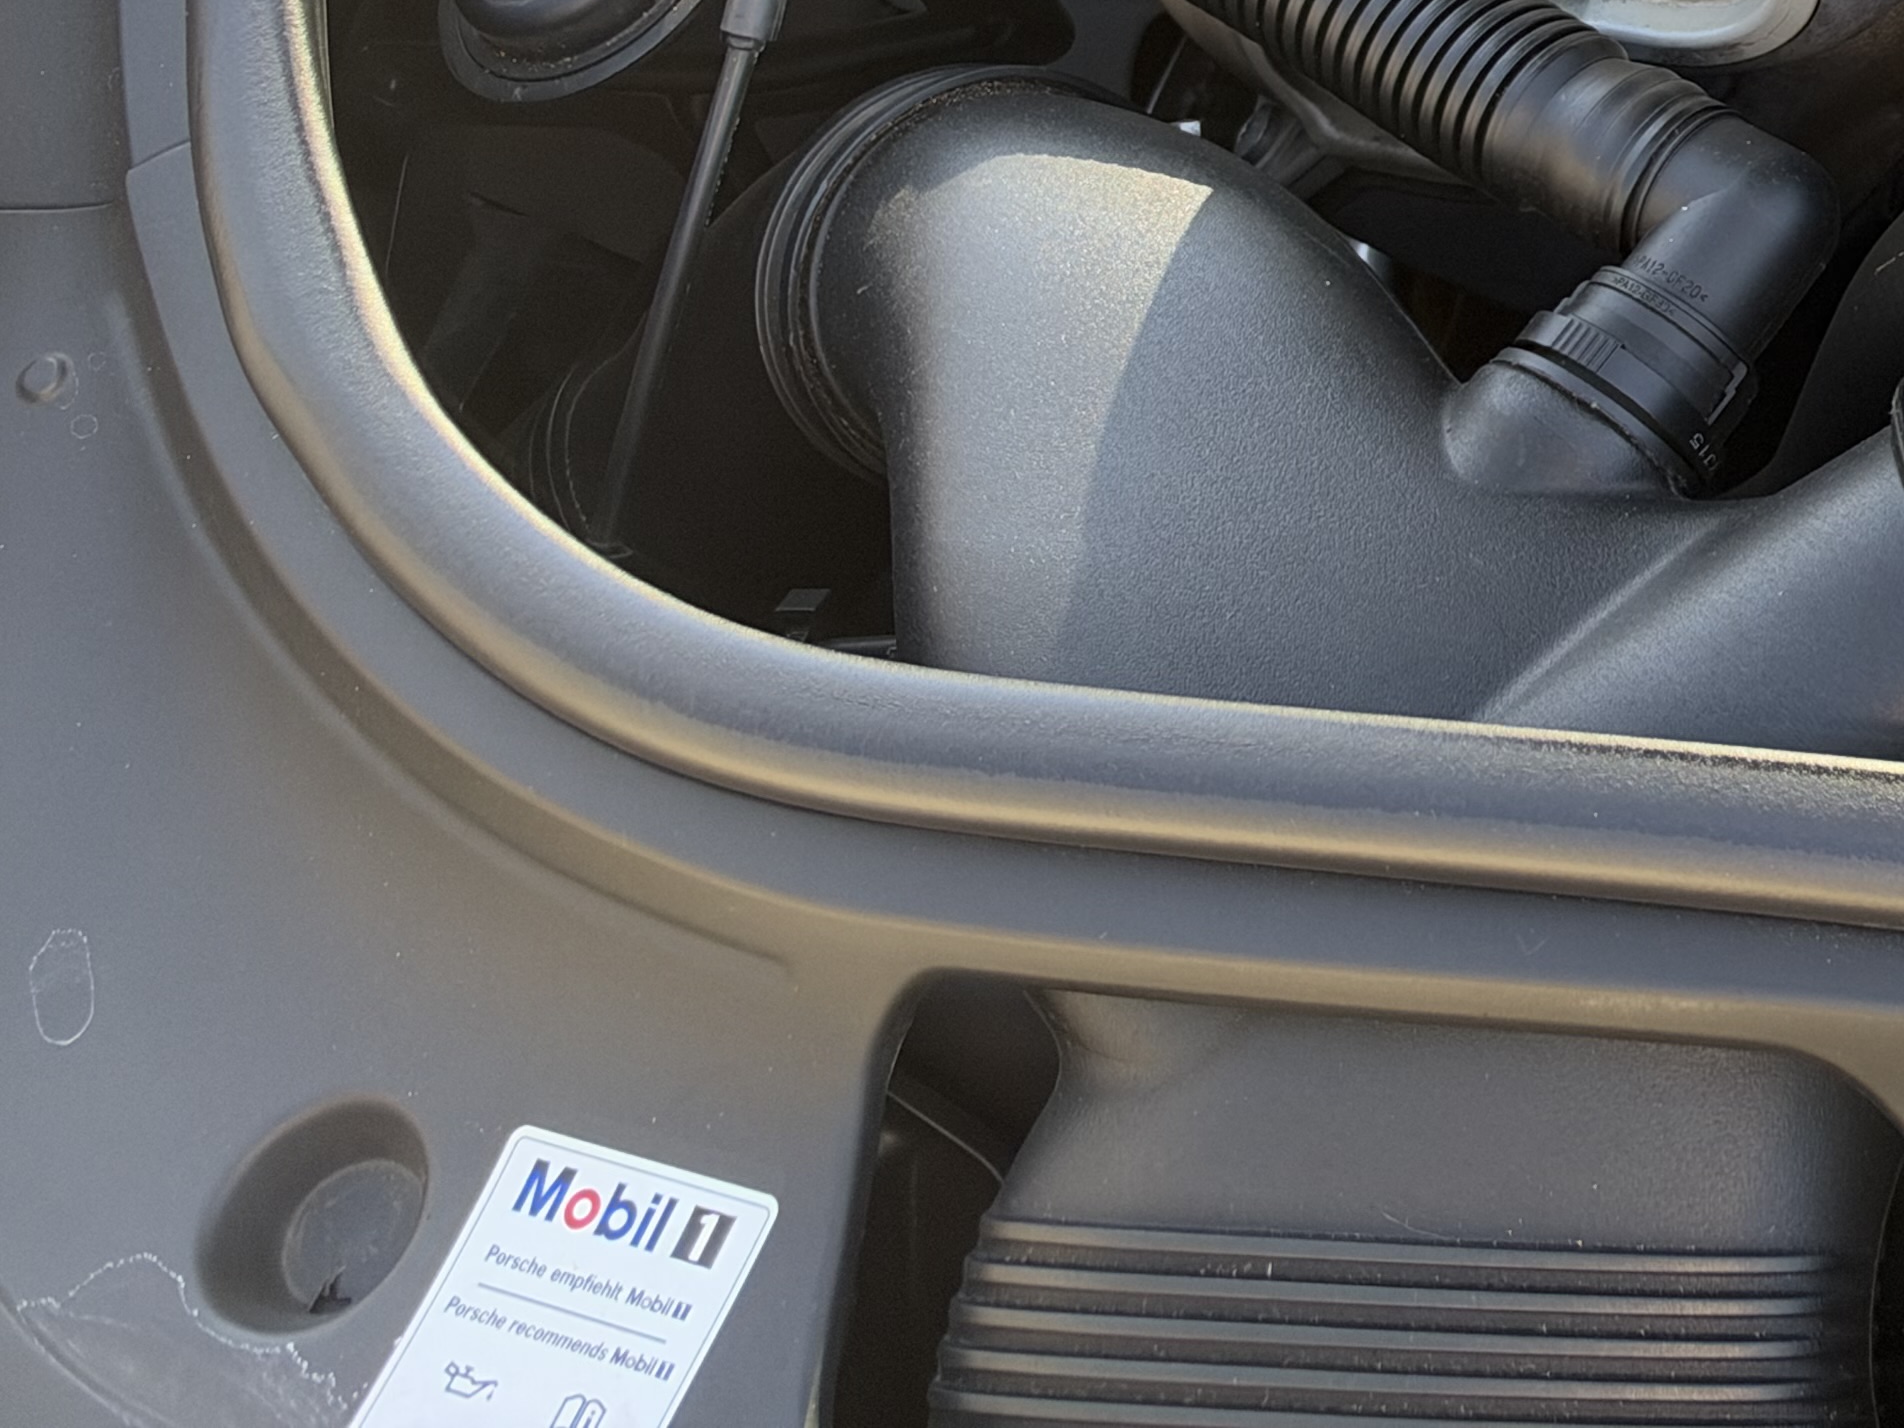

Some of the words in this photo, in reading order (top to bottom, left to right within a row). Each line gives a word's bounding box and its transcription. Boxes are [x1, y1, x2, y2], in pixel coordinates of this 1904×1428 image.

[512, 1158, 680, 1253] Mobil
[484, 1243, 548, 1279] Porsche
[550, 1265, 624, 1303] empfiehlt
[443, 1295, 506, 1330] Porsche
[507, 1319, 609, 1361] recommends
